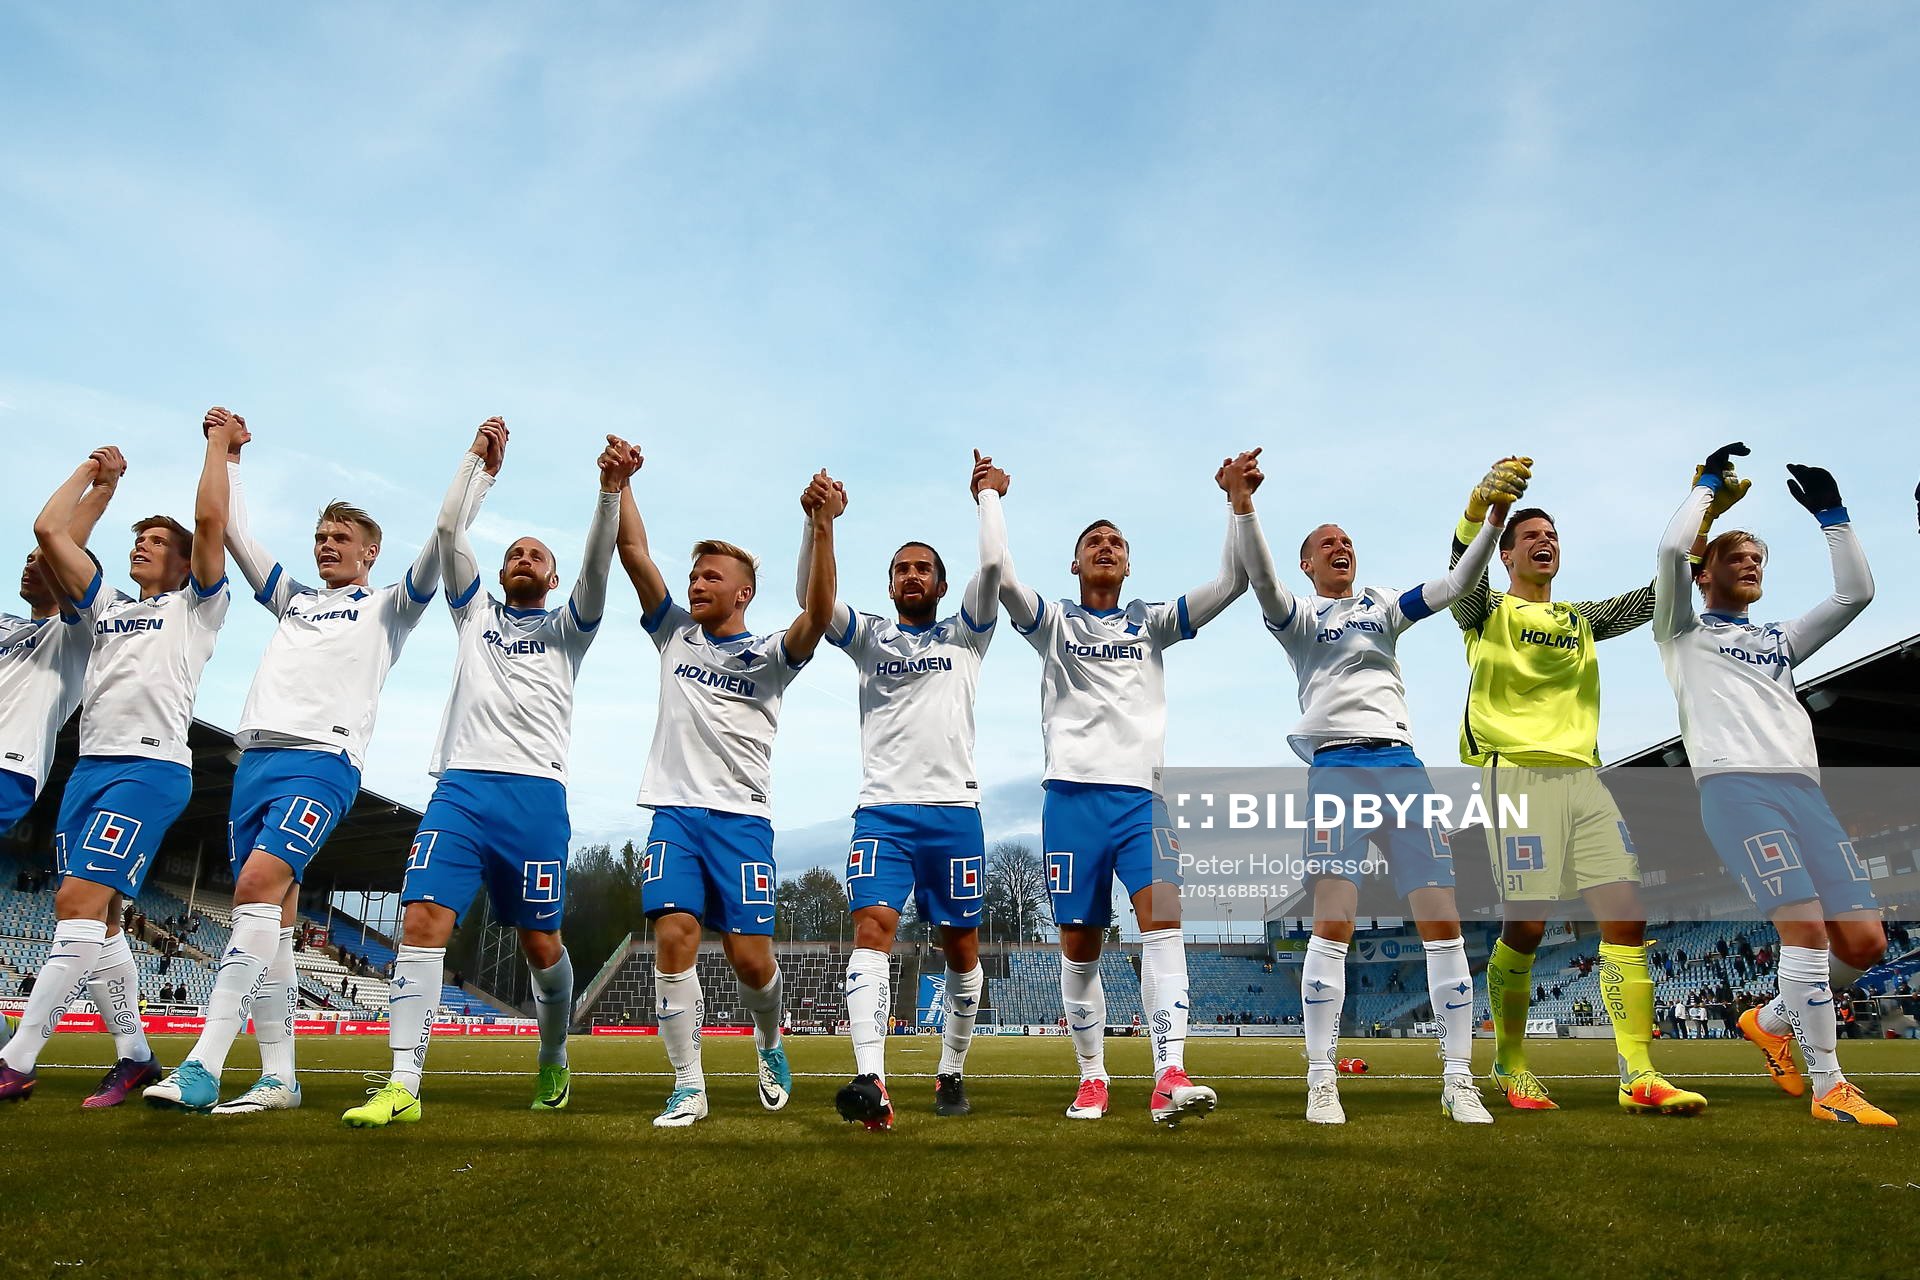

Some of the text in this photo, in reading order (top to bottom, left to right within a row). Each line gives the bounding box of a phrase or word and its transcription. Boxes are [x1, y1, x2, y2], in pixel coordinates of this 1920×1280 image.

[95, 618, 164, 636] OLMEN
[877, 657, 952, 676] HOLMEN
[1065, 641, 1143, 661] HOLMEN
[674, 663, 756, 697] HOLMEN
[1507, 874, 1524, 892] 31
[1762, 876, 1782, 897] 17
[107, 977, 128, 1011] suez
[250, 966, 269, 1000] suez
[878, 982, 888, 1012] suez
[1605, 984, 1627, 1020] suez
[420, 1009, 435, 1044] suez
[1787, 1010, 1807, 1044] suez
